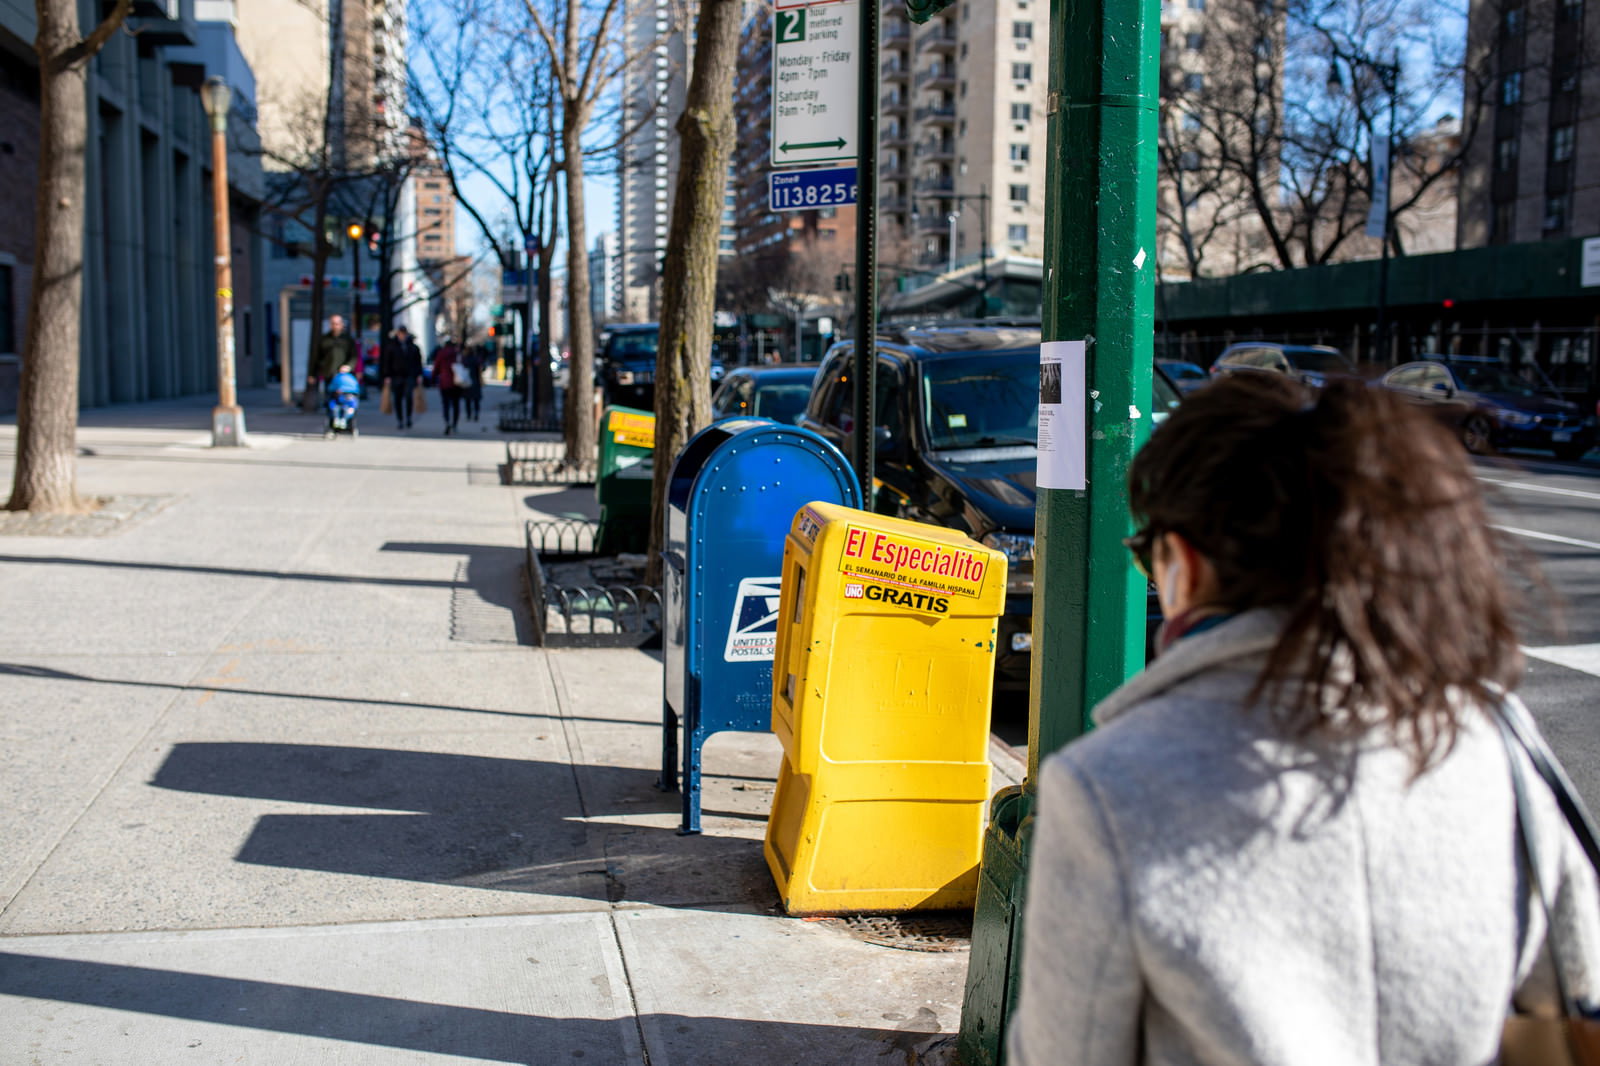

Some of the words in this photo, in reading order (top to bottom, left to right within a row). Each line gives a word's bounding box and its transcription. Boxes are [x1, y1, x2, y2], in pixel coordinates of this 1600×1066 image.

[783, 10, 800, 40] 2
[809, 16, 842, 28] metered
[809, 29, 839, 42] parking
[779, 53, 813, 67] Monday
[822, 50, 851, 63] Friday
[779, 71, 800, 83] 4pm
[808, 67, 828, 82] 7pm
[779, 89, 819, 103] Saturday
[778, 105, 799, 117] 9am
[807, 102, 827, 116] 7pm
[846, 529, 866, 558] El
[871, 534, 984, 582] Especialito
[856, 565, 896, 580] SEMANARIO
[897, 574, 907, 582] DE
[908, 576, 918, 584] LA
[919, 578, 946, 590] FAMILIA
[947, 584, 975, 596] HISPANA
[845, 586, 863, 598] UNO
[865, 585, 949, 613] GRATIS
[733, 637, 768, 647] UNITED
[731, 647, 764, 656] POSTAL
